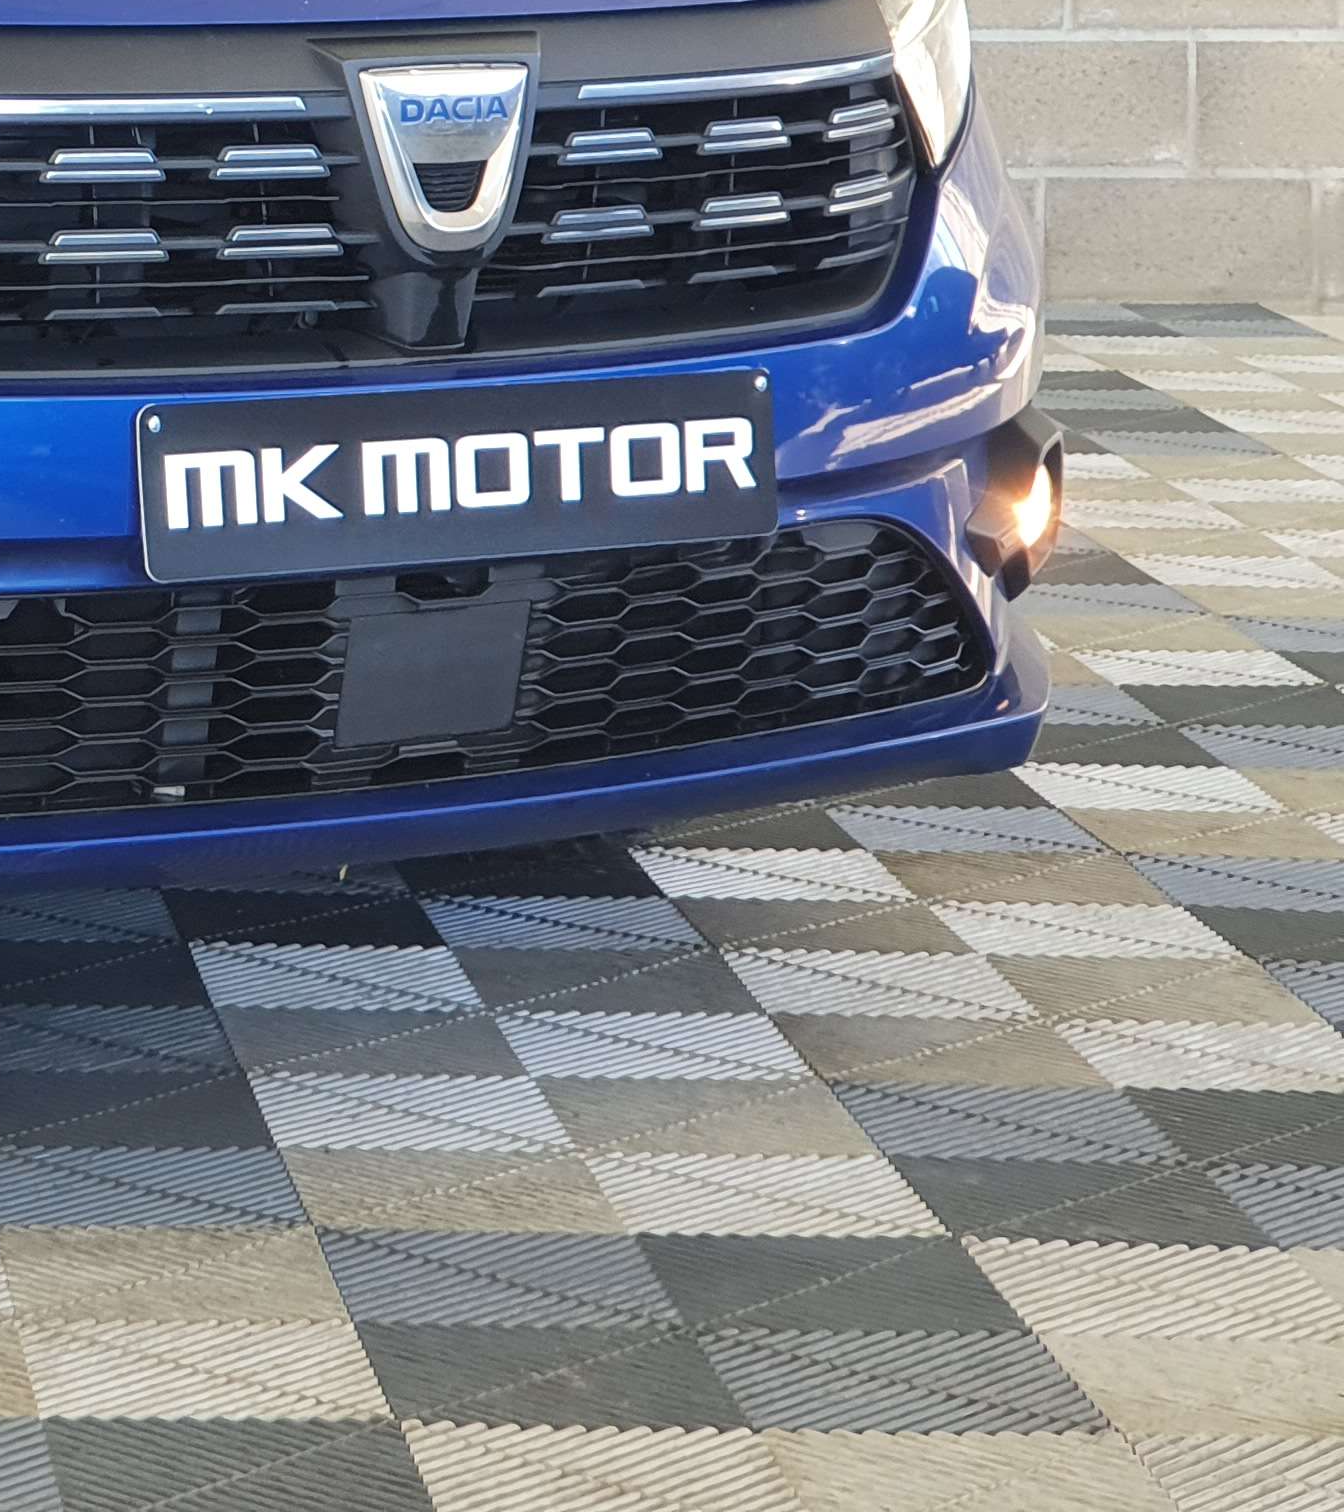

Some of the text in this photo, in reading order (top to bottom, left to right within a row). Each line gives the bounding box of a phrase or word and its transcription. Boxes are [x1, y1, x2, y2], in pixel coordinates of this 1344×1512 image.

[399, 95, 509, 124] DACIA
[163, 416, 757, 530] MK MOTOR
